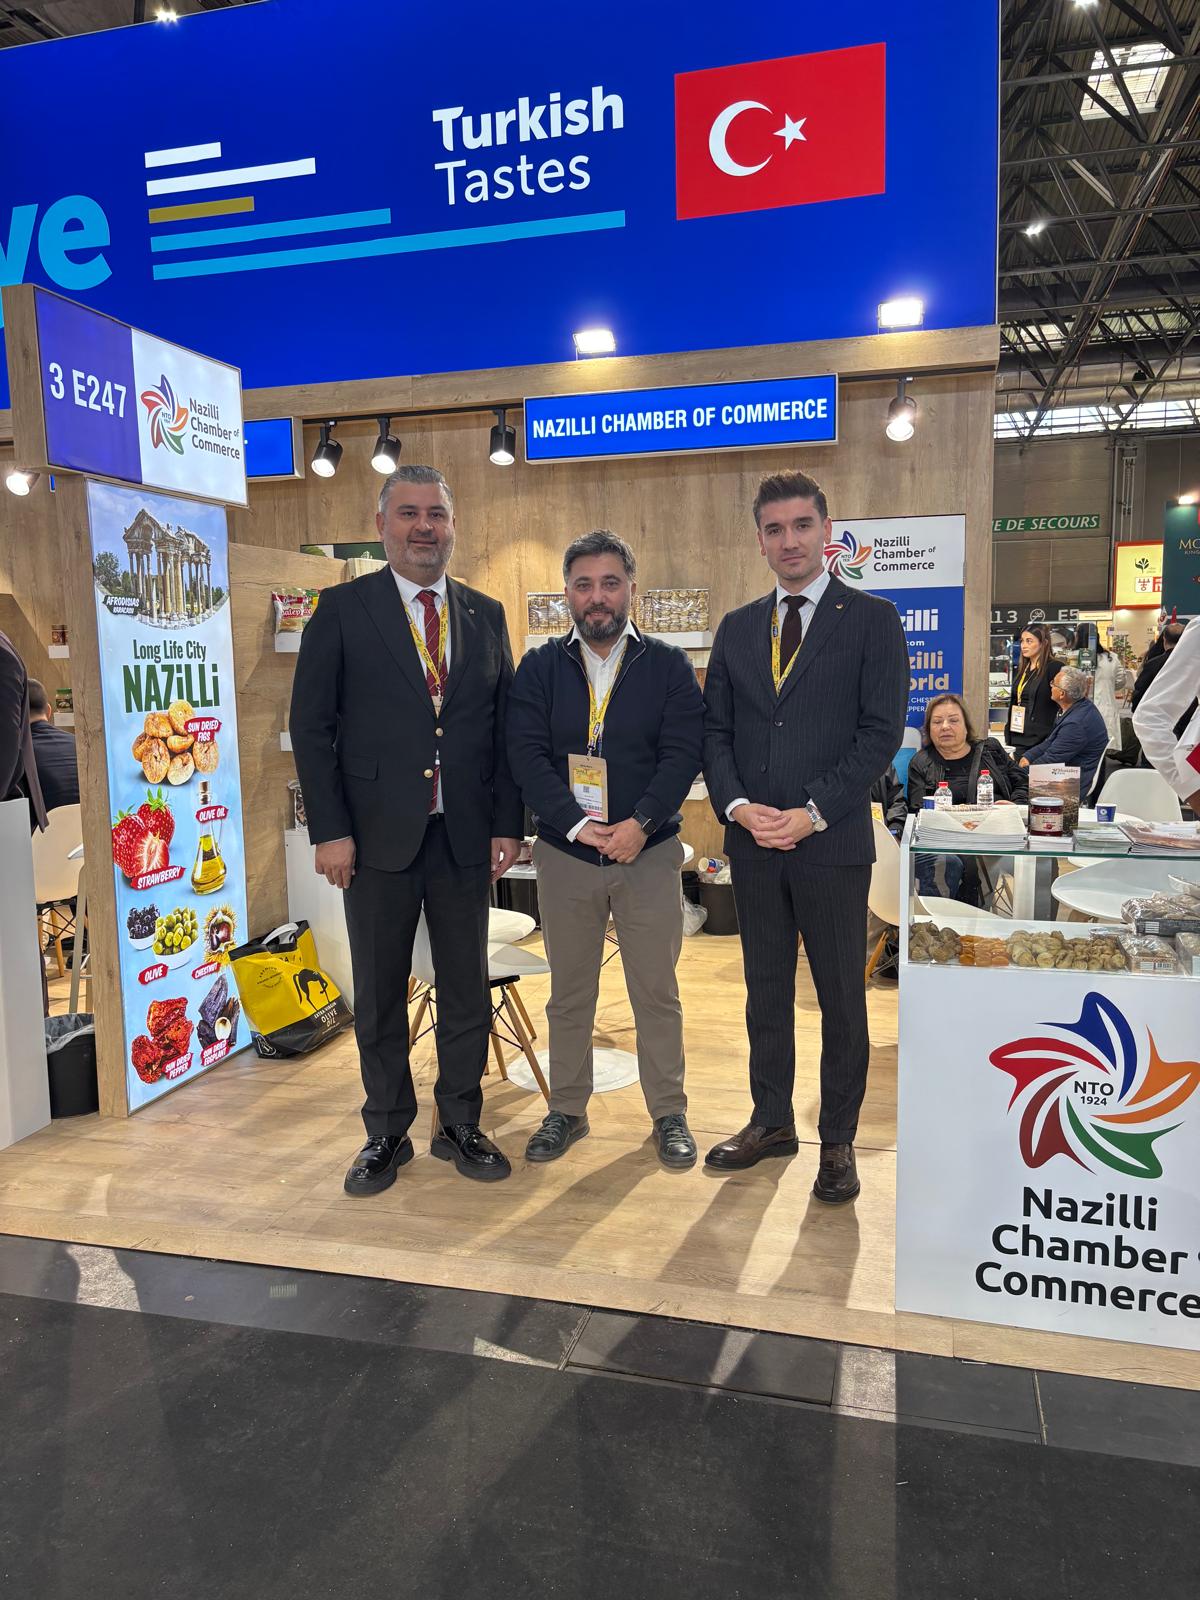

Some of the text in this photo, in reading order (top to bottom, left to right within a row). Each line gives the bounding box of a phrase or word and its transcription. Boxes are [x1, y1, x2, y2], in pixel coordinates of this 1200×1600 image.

[432, 85, 624, 152] Turkish
[434, 154, 591, 206] Tastes
[49, 362, 127, 418] 3 E247
[189, 396, 220, 421] Nazilli
[532, 398, 828, 439] NAZILLI CHAMBER OF COMMERCE
[190, 416, 240, 441] Chamber of
[191, 433, 240, 460] Commerce
[1006, 518, 1026, 531] DE
[1030, 515, 1099, 530] SECOURS
[873, 536, 910, 548] Nazilli
[873, 547, 926, 560] Chamber
[873, 561, 935, 572] Commerce
[133, 639, 207, 664] Long Life City
[188, 719, 219, 733] SUN DRIED
[197, 731, 211, 742] FIGS
[199, 807, 226, 822] OLIVE OIL
[137, 866, 181, 889] STRAWBERRY
[144, 965, 164, 983] OLIVE
[195, 962, 218, 979] CHESTNUT
[321, 1008, 338, 1023] OLIVE
[326, 1017, 336, 1028] OIL
[203, 1040, 227, 1059] SUN DRIED
[165, 1052, 191, 1073] SUN DRIED
[169, 1062, 189, 1080] PEPPER
[1073, 1080, 1115, 1097] NTO
[1080, 1095, 1108, 1106] 1924
[1022, 1186, 1158, 1232] Nazilli
[991, 1224, 1188, 1275] Chamber
[974, 1261, 1200, 1319] Commerce
